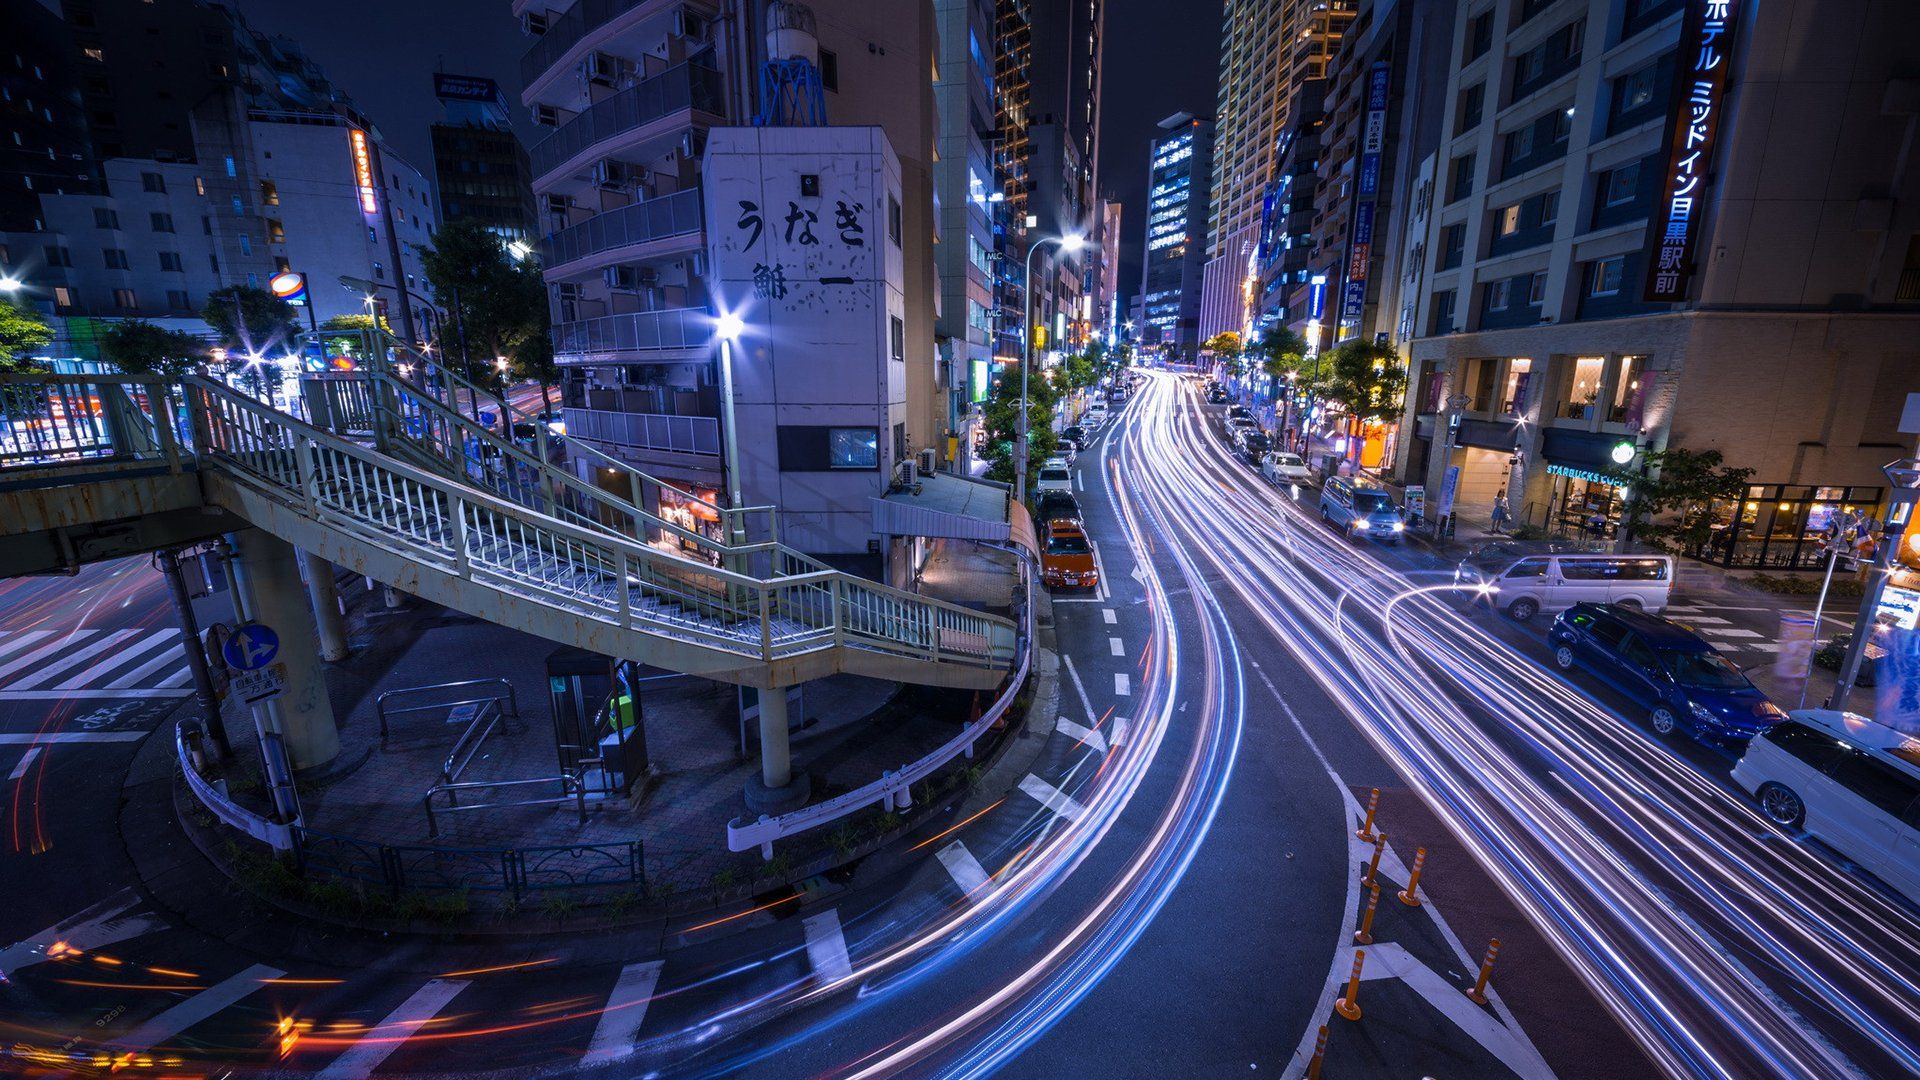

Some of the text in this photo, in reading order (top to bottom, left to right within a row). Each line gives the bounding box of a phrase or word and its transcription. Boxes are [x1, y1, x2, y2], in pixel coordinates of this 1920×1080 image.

[1655, 0, 1729, 293] ホテル ミッドイン目黒駅前
[737, 200, 864, 253] うなぎ
[987, 252, 1003, 261] MLC
[986, 309, 1002, 318] MLC
[1546, 464, 1600, 483] STARBUCKS
